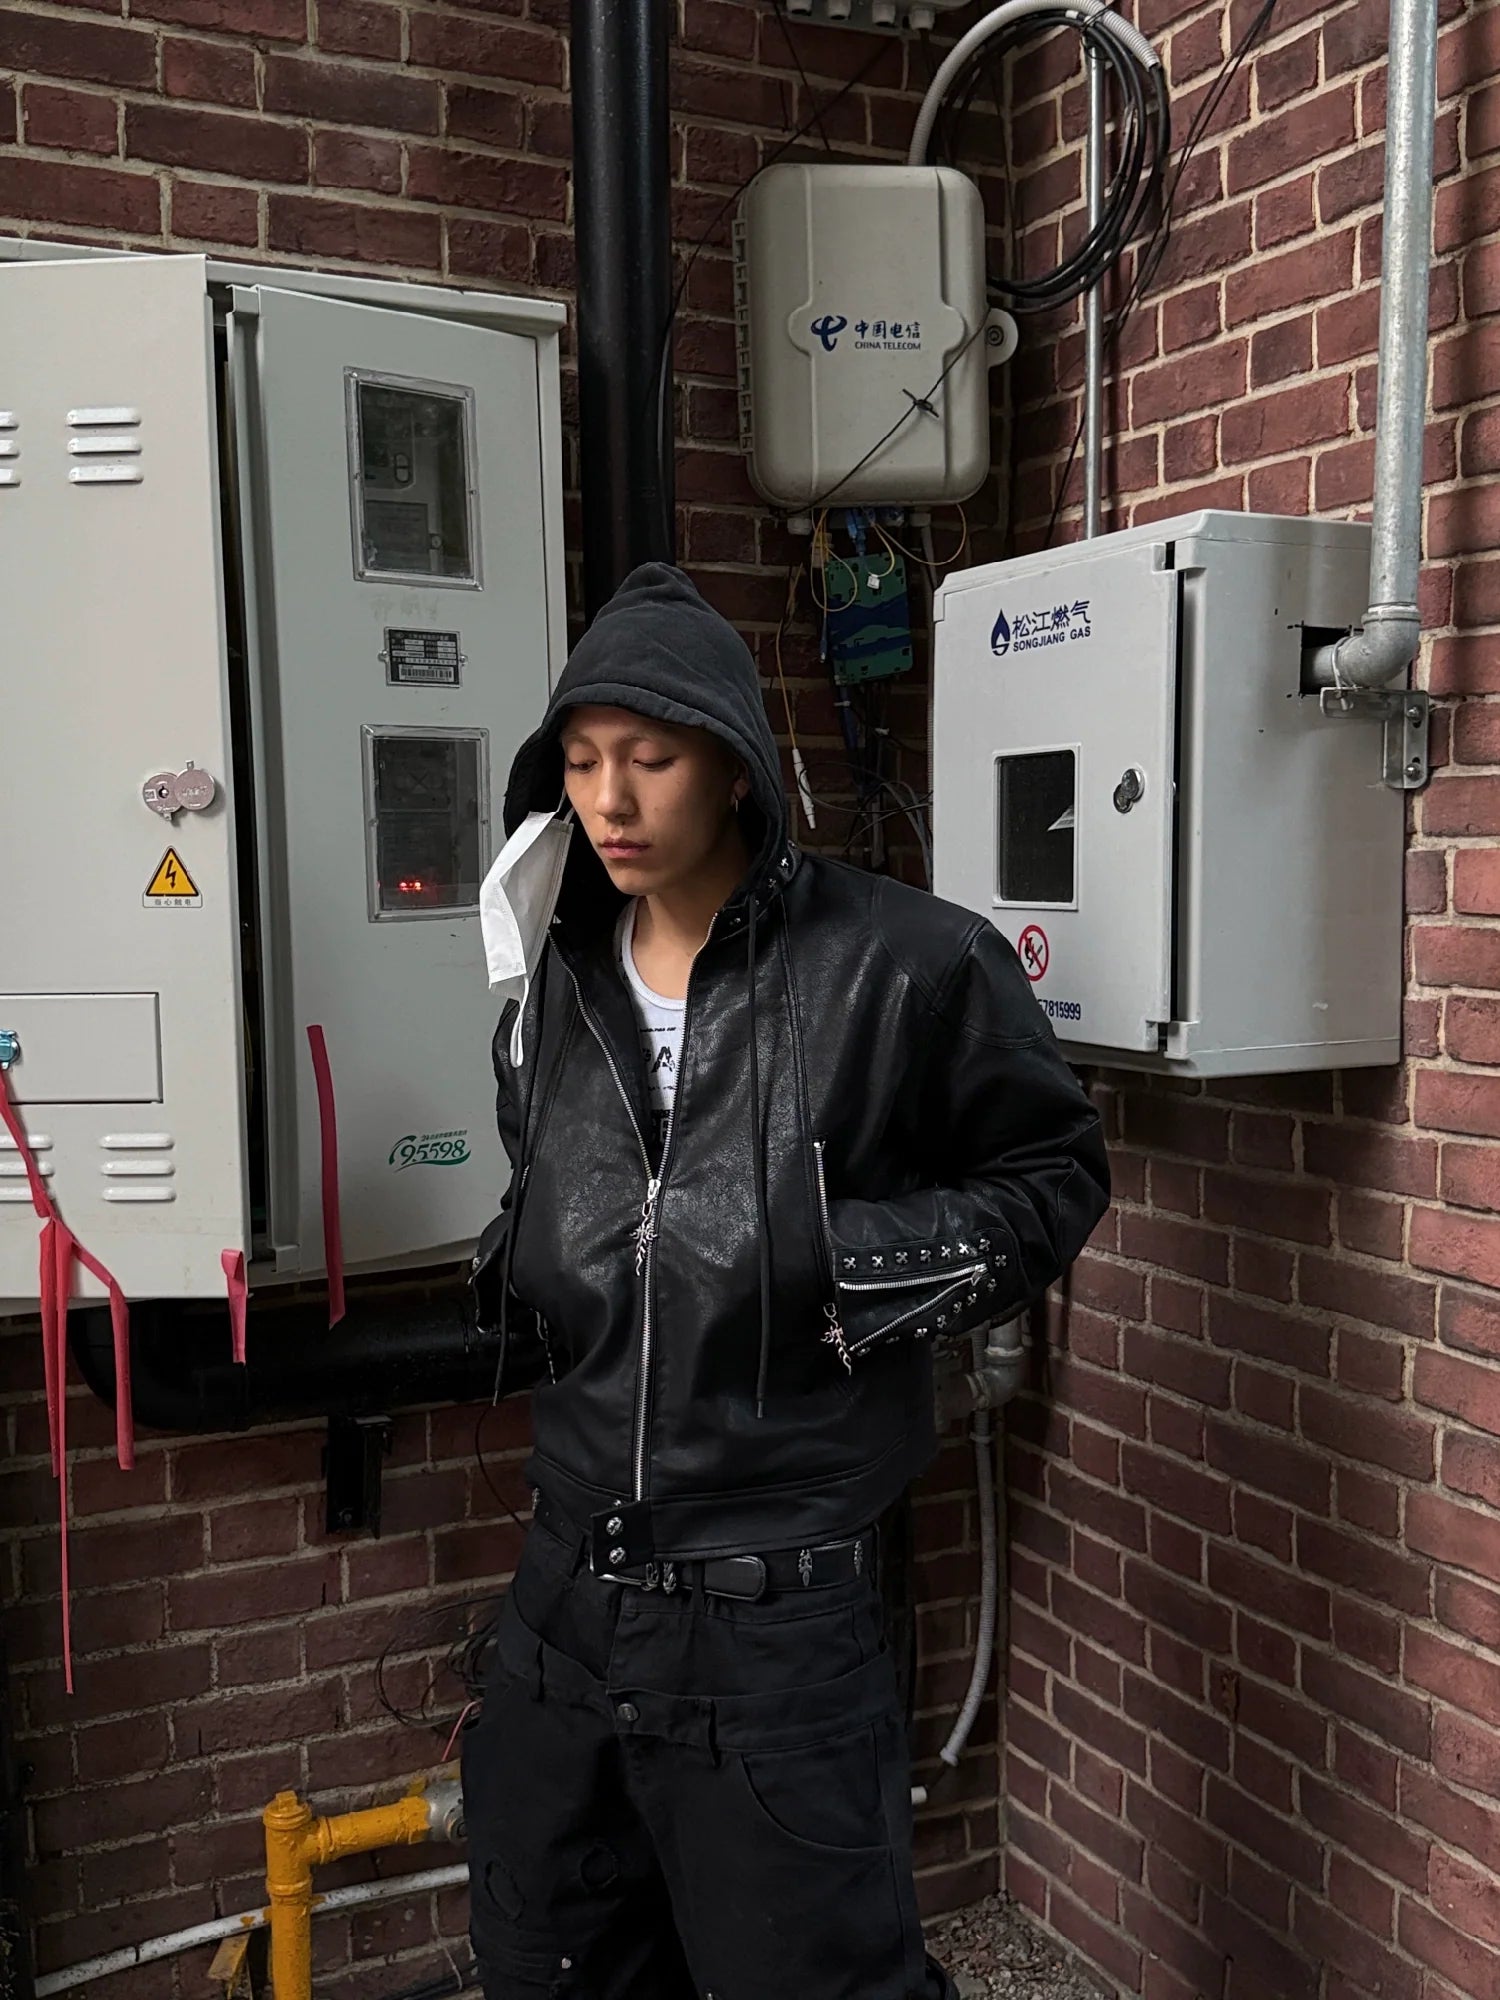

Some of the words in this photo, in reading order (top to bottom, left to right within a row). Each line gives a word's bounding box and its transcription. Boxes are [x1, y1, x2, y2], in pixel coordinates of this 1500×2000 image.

[854, 320, 921, 339] 中国电信
[854, 341, 881, 350] CHINA
[883, 342, 921, 351] TELECOM
[1012, 600, 1091, 639] 松江燃气
[1013, 632, 1065, 652] SONGJIANG
[1070, 626, 1091, 640] GAS
[1037, 999, 1081, 1021] 7815999
[400, 1139, 466, 1166] 95598
